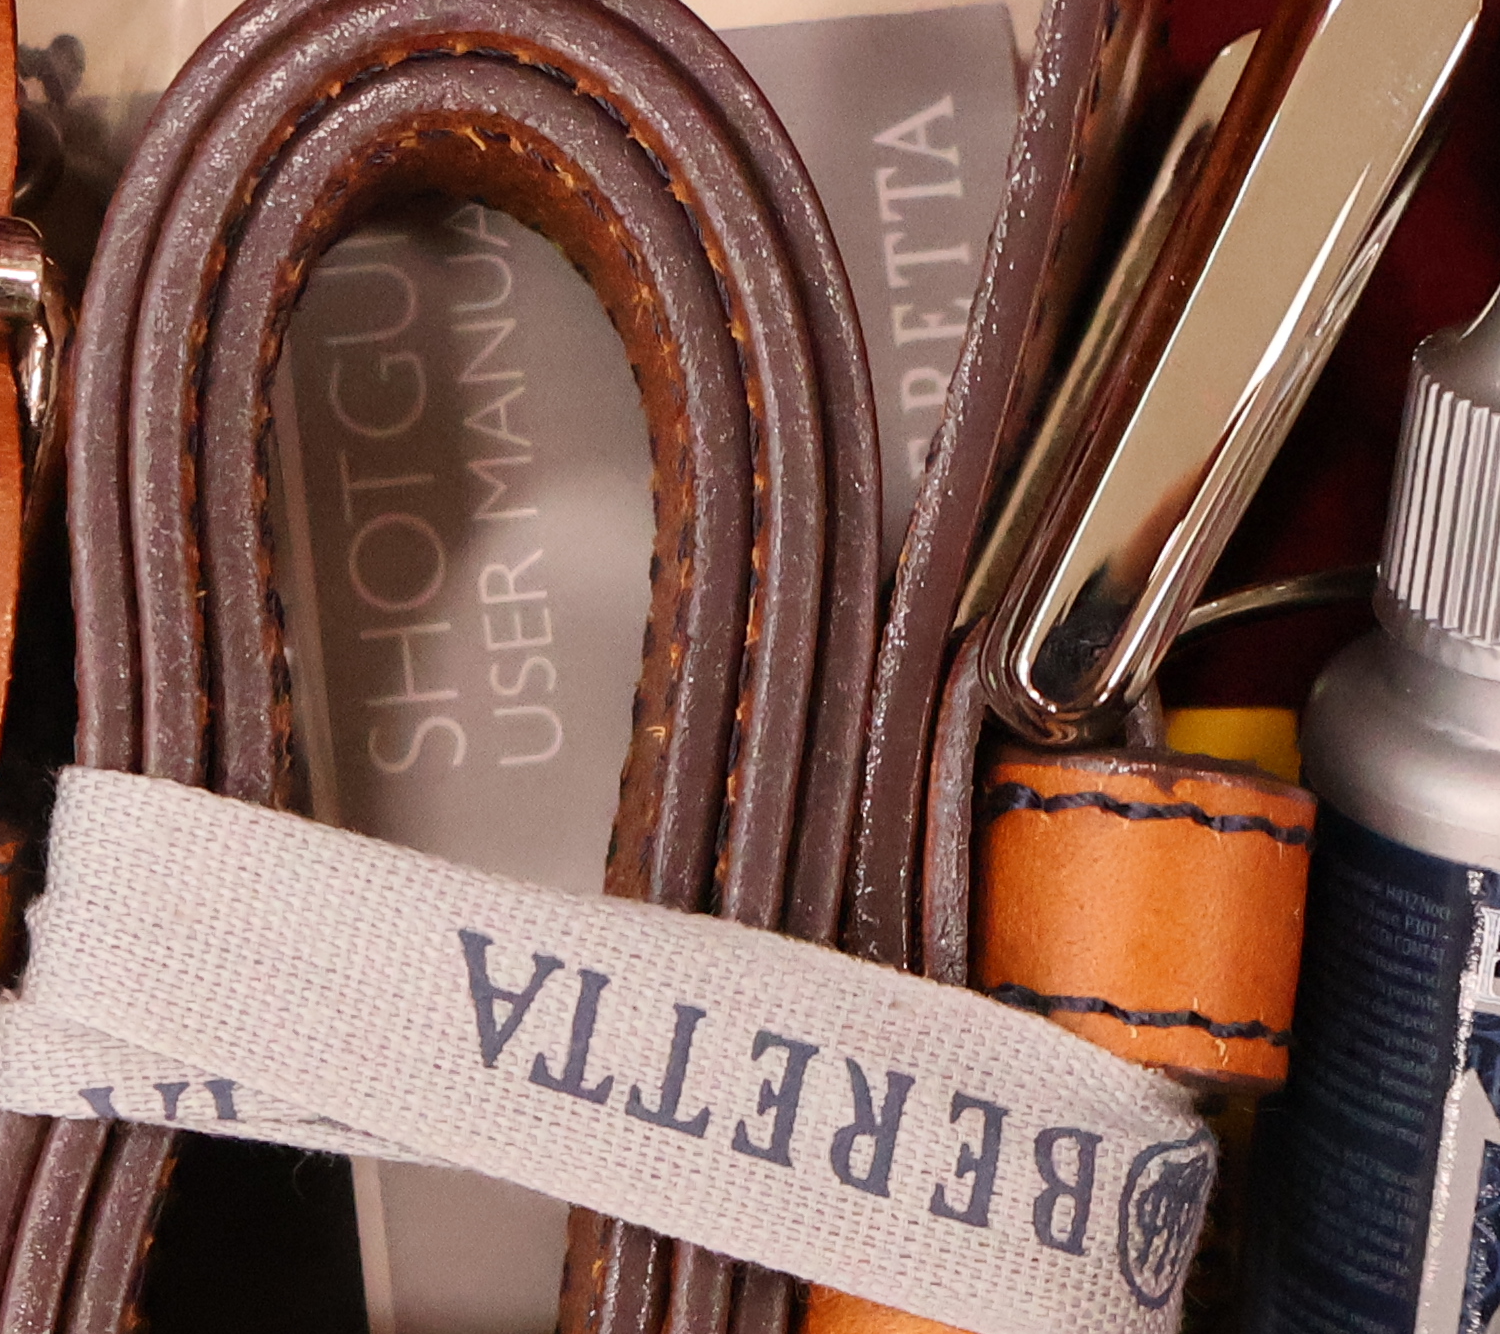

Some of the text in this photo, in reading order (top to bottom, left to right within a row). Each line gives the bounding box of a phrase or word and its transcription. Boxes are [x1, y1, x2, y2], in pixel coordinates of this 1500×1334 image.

[872, 92, 978, 483] RETTA
[443, 202, 565, 767] USER MANUA
[458, 927, 1103, 1256] BERETTA
